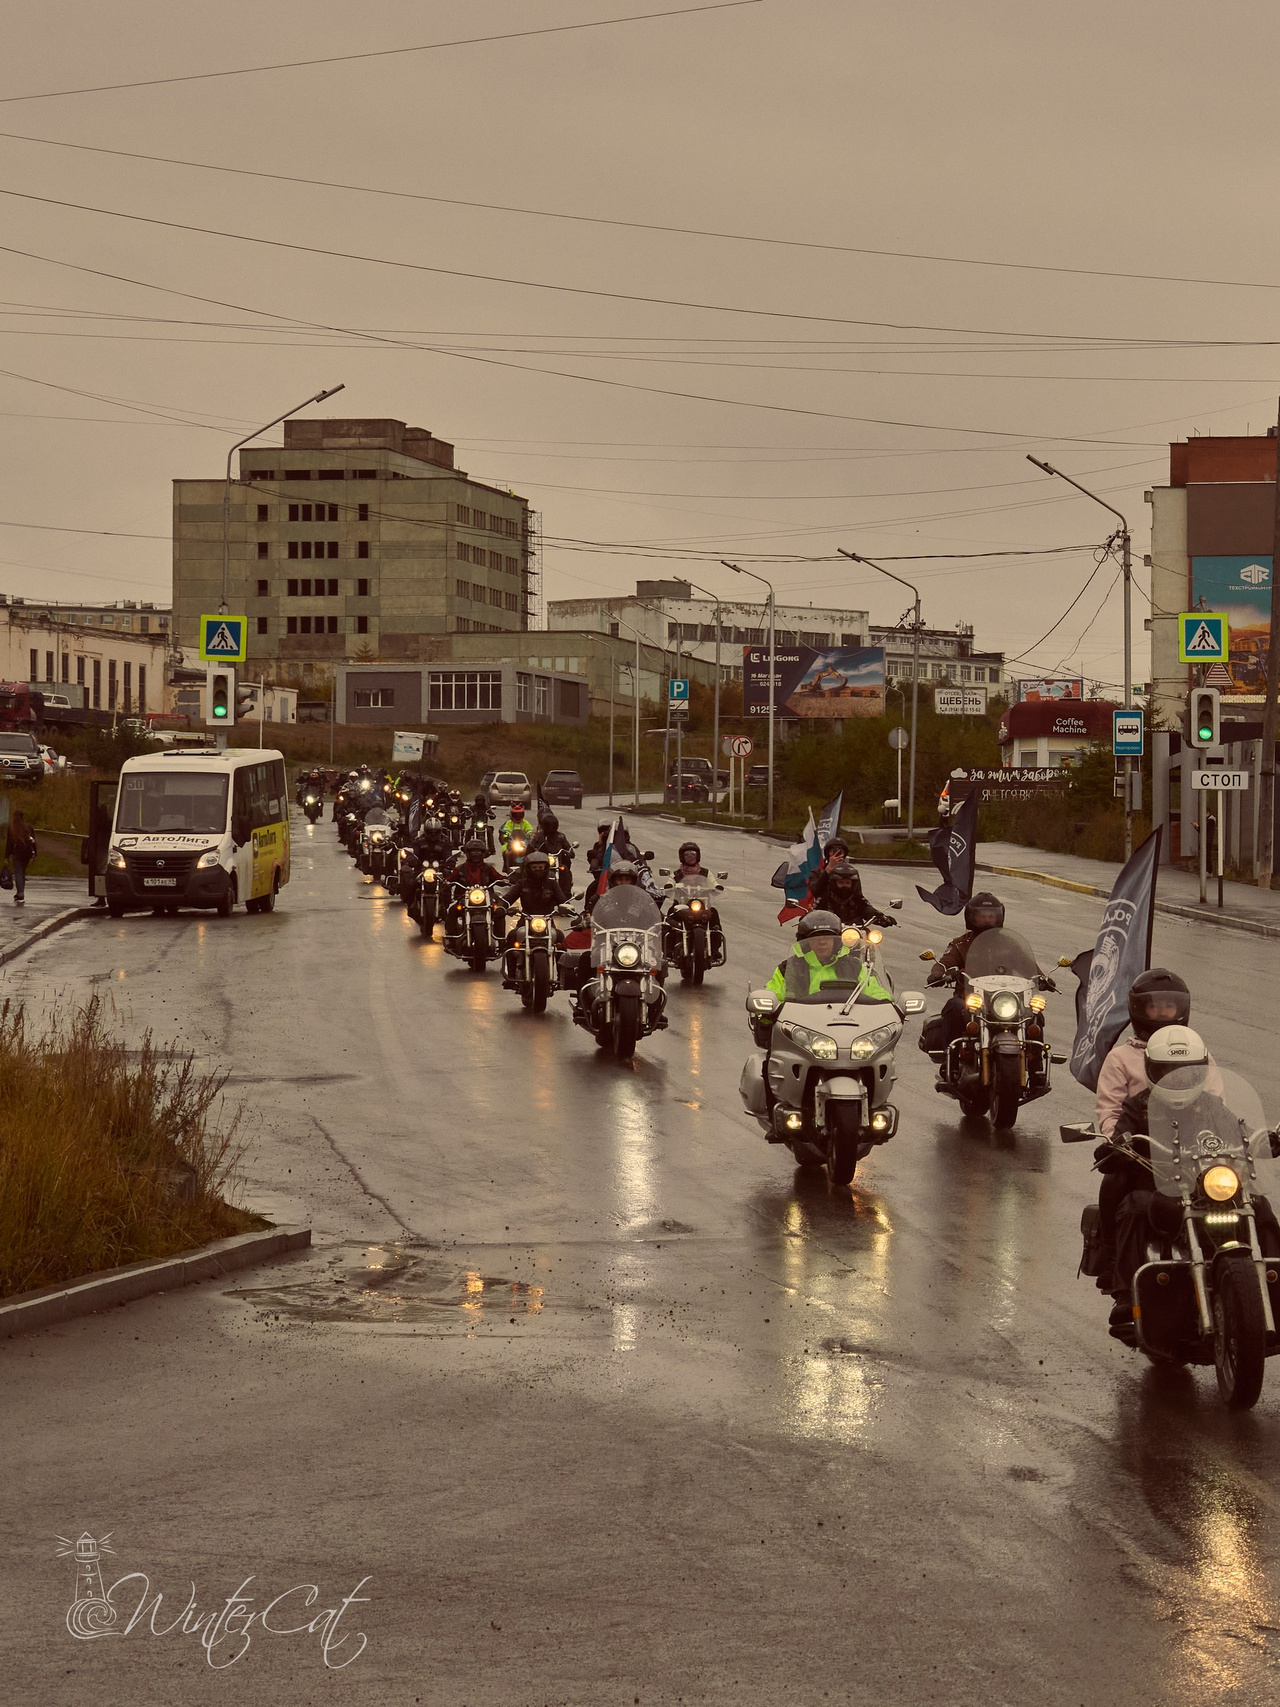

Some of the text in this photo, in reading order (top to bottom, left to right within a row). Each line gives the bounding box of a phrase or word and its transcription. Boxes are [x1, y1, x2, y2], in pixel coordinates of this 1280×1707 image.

[673, 681, 685, 697] P
[940, 697, 981, 706] ЩЕБЕНЬ
[1055, 717, 1084, 726] Coffee
[1052, 725, 1088, 734] Machine
[1200, 774, 1241, 787] СТОП
[142, 835, 210, 845] АвтоЛига
